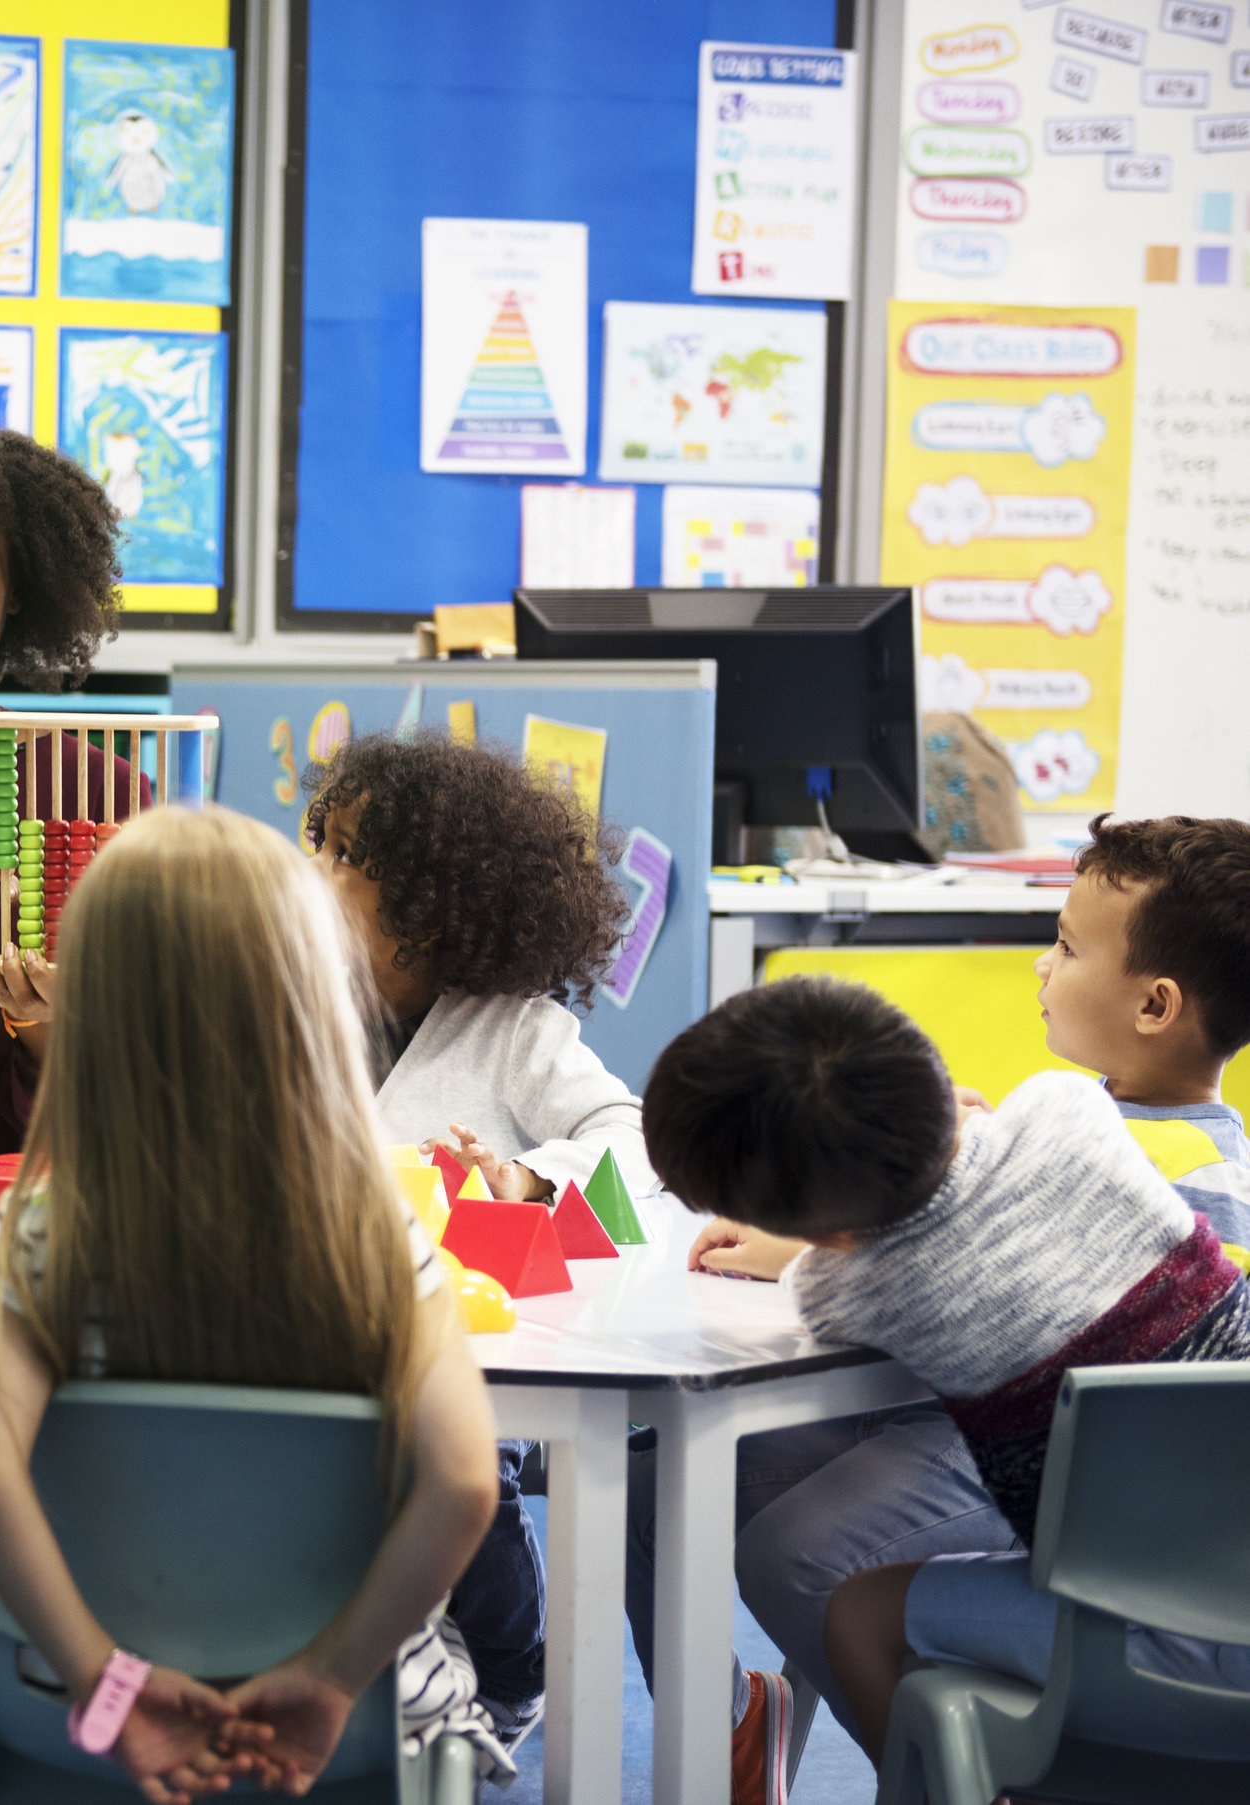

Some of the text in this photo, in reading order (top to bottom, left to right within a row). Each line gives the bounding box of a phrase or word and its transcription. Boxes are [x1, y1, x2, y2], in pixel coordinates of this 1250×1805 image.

[932, 33, 1001, 60] Monday
[1067, 17, 1135, 52] BECAUSE
[932, 86, 1005, 121] Tuesday
[922, 139, 1019, 167] Wednesday
[930, 184, 1012, 218] Thursday
[932, 235, 989, 266] Friday
[972, 333, 1037, 362] Class
[1044, 337, 1105, 362] Rules
